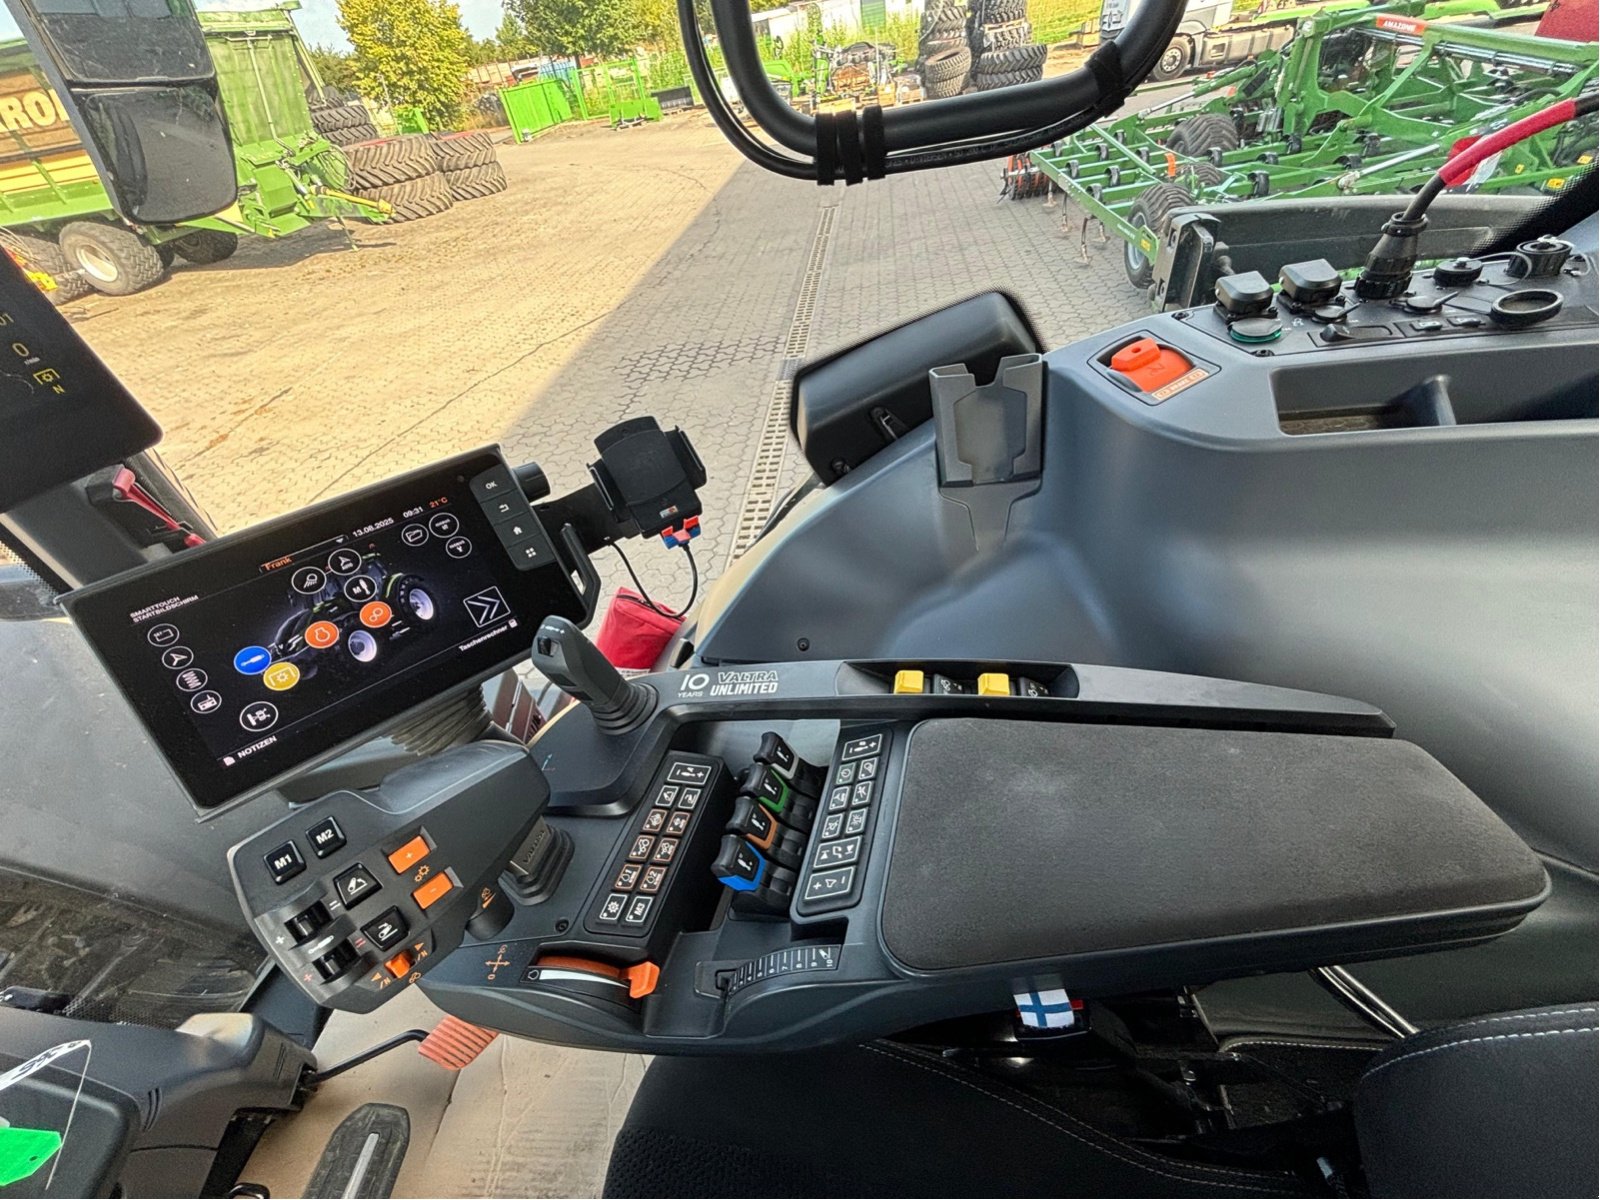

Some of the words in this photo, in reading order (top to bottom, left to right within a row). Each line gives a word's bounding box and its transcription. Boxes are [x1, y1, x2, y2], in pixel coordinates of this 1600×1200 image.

[485, 480, 498, 490] OK
[352, 517, 395, 538] 13.08.2025
[402, 506, 424, 518] 09:31
[262, 556, 293, 571] Frank
[130, 596, 180, 618] SMARTTOUCH
[132, 594, 199, 623] STARTBILDSCHIRM
[459, 625, 508, 652] Taschenrechner
[680, 673, 710, 691] 10
[718, 670, 779, 684] VALTRA
[677, 690, 704, 698] YEARS
[710, 682, 779, 696] UNLIMITED
[237, 735, 277, 759] NOTIZEN
[316, 829, 335, 844] M2
[274, 854, 292, 870] M1
[633, 902, 645, 916] M3
[826, 959, 833, 968] 10
